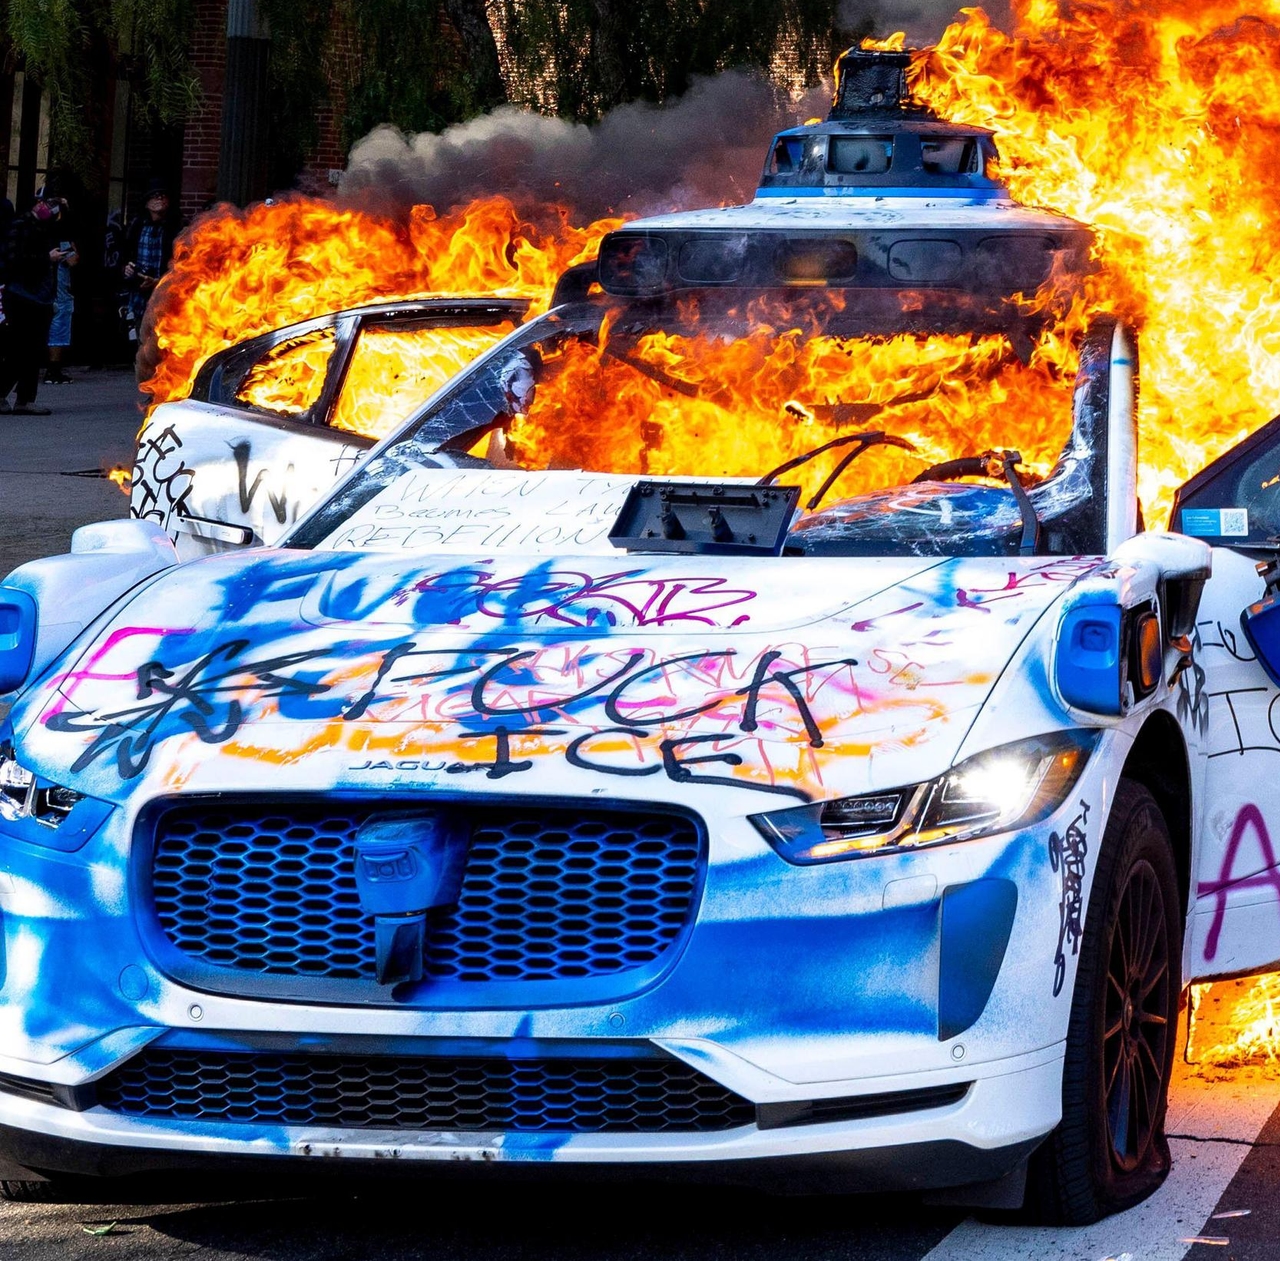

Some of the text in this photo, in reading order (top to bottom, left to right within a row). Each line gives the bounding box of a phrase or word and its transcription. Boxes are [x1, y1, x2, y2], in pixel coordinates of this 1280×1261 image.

[400, 474, 548, 502] WHEN
[343, 642, 858, 748] FUCK
[459, 725, 813, 803] ICE
